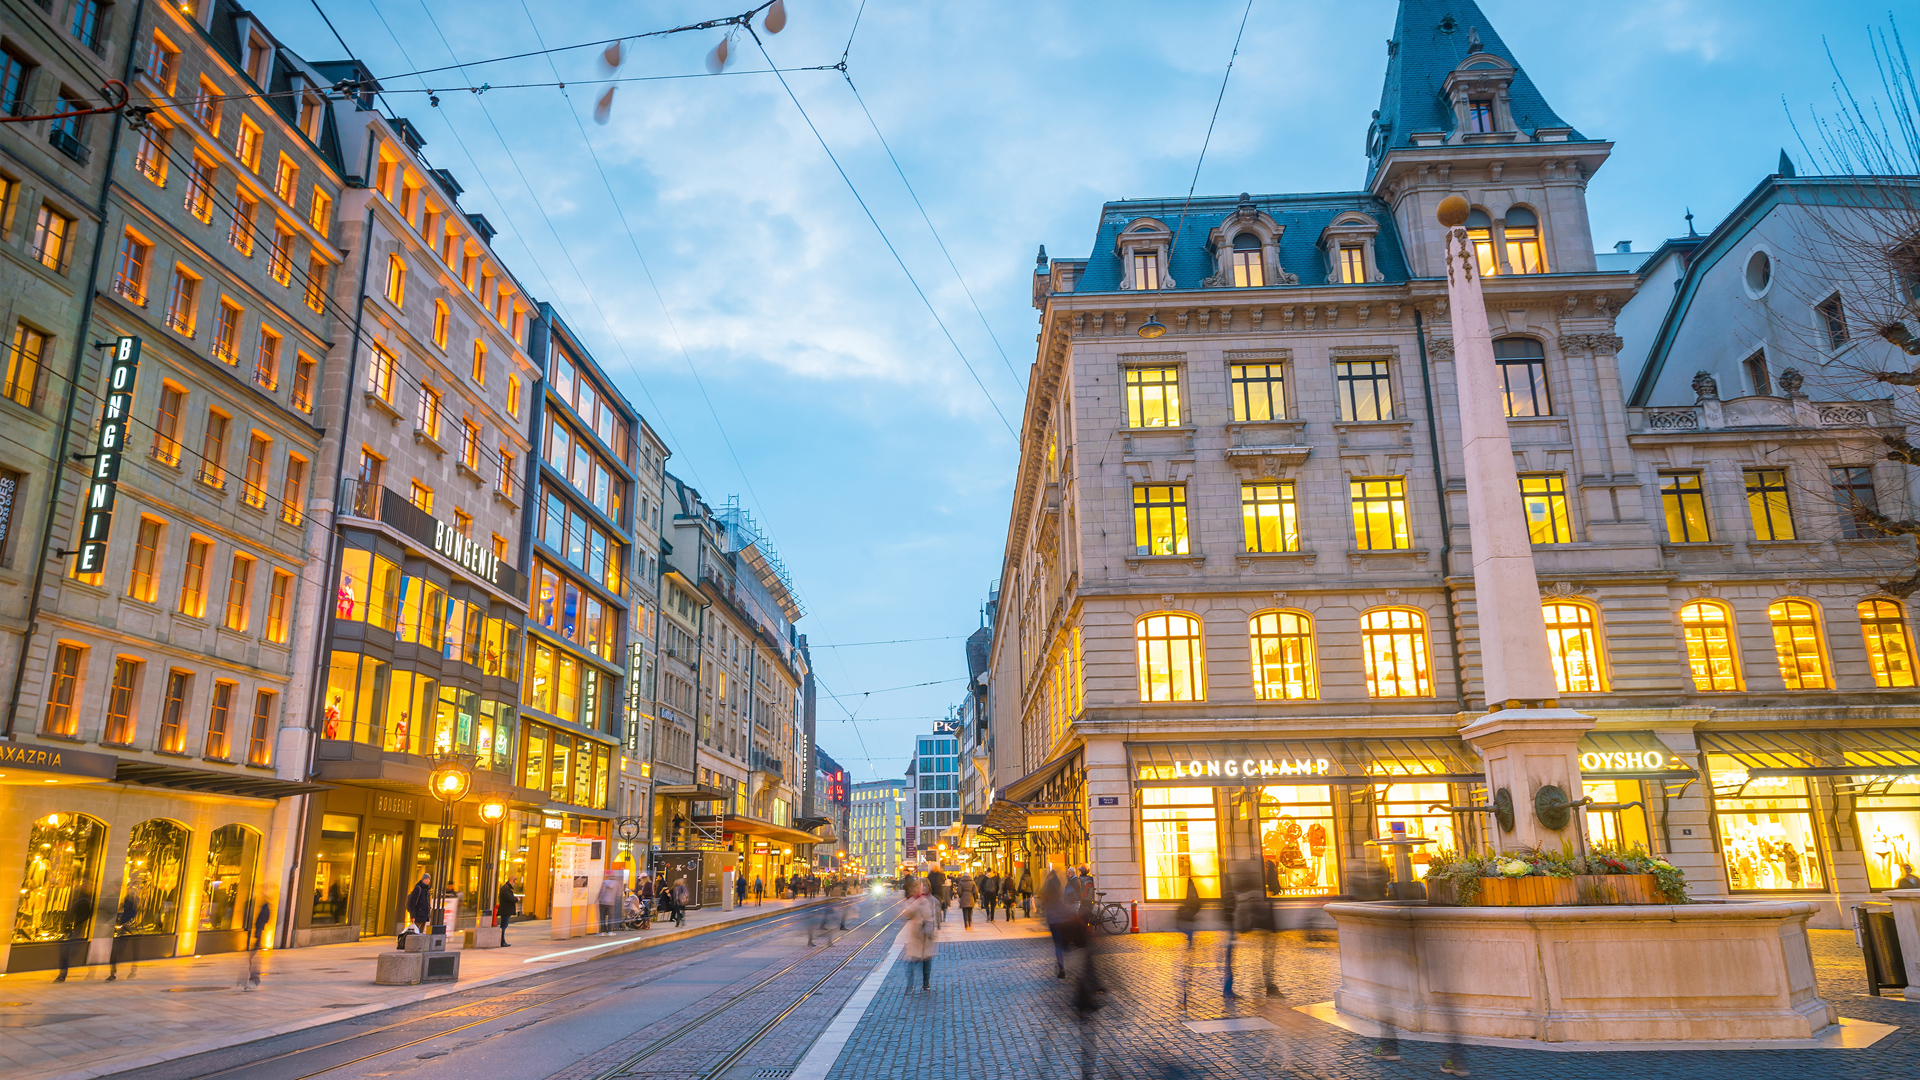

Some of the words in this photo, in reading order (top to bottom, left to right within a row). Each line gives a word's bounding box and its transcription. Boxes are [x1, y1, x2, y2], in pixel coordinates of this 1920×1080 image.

[81, 338, 132, 570] BONGENIE
[8, 480, 16, 493] 00
[434, 519, 500, 584] BONGENIE
[629, 643, 642, 750] BONGENIE
[1175, 758, 1330, 778] LONGCHAMP
[1581, 750, 1663, 770] OYSHO
[378, 796, 412, 814] BONGENIE
